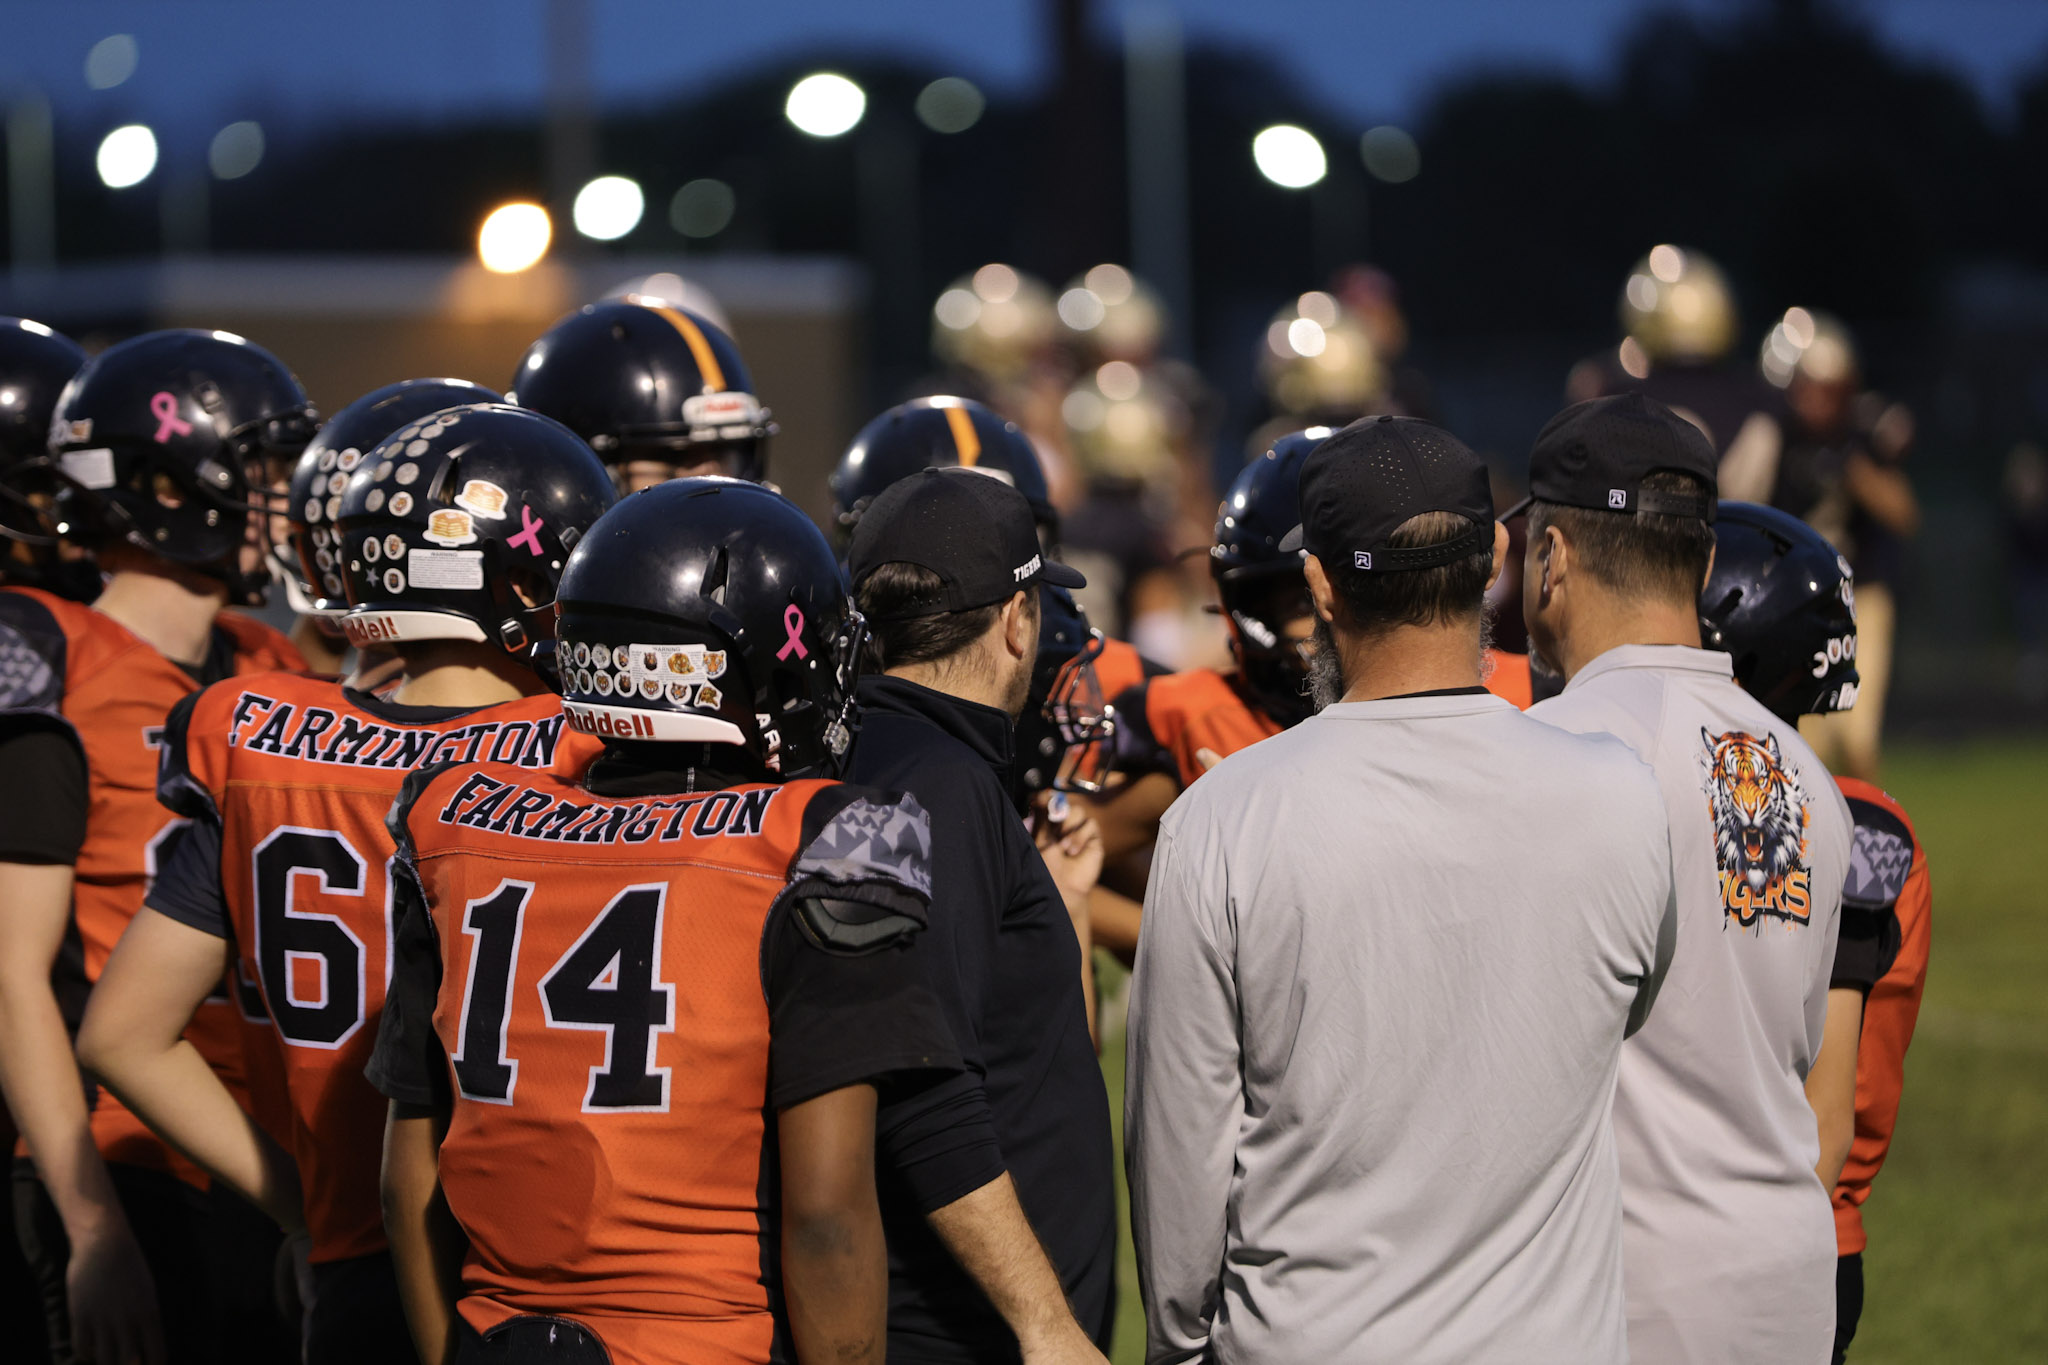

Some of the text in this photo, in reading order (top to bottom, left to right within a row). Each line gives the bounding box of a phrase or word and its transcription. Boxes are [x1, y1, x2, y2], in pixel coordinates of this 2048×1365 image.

[1013, 553, 1041, 582] TIGERS
[228, 690, 567, 770] FARMINGTON
[563, 706, 655, 739] Riddell
[438, 771, 784, 845] FARMINGTON
[451, 878, 676, 1113] 14
